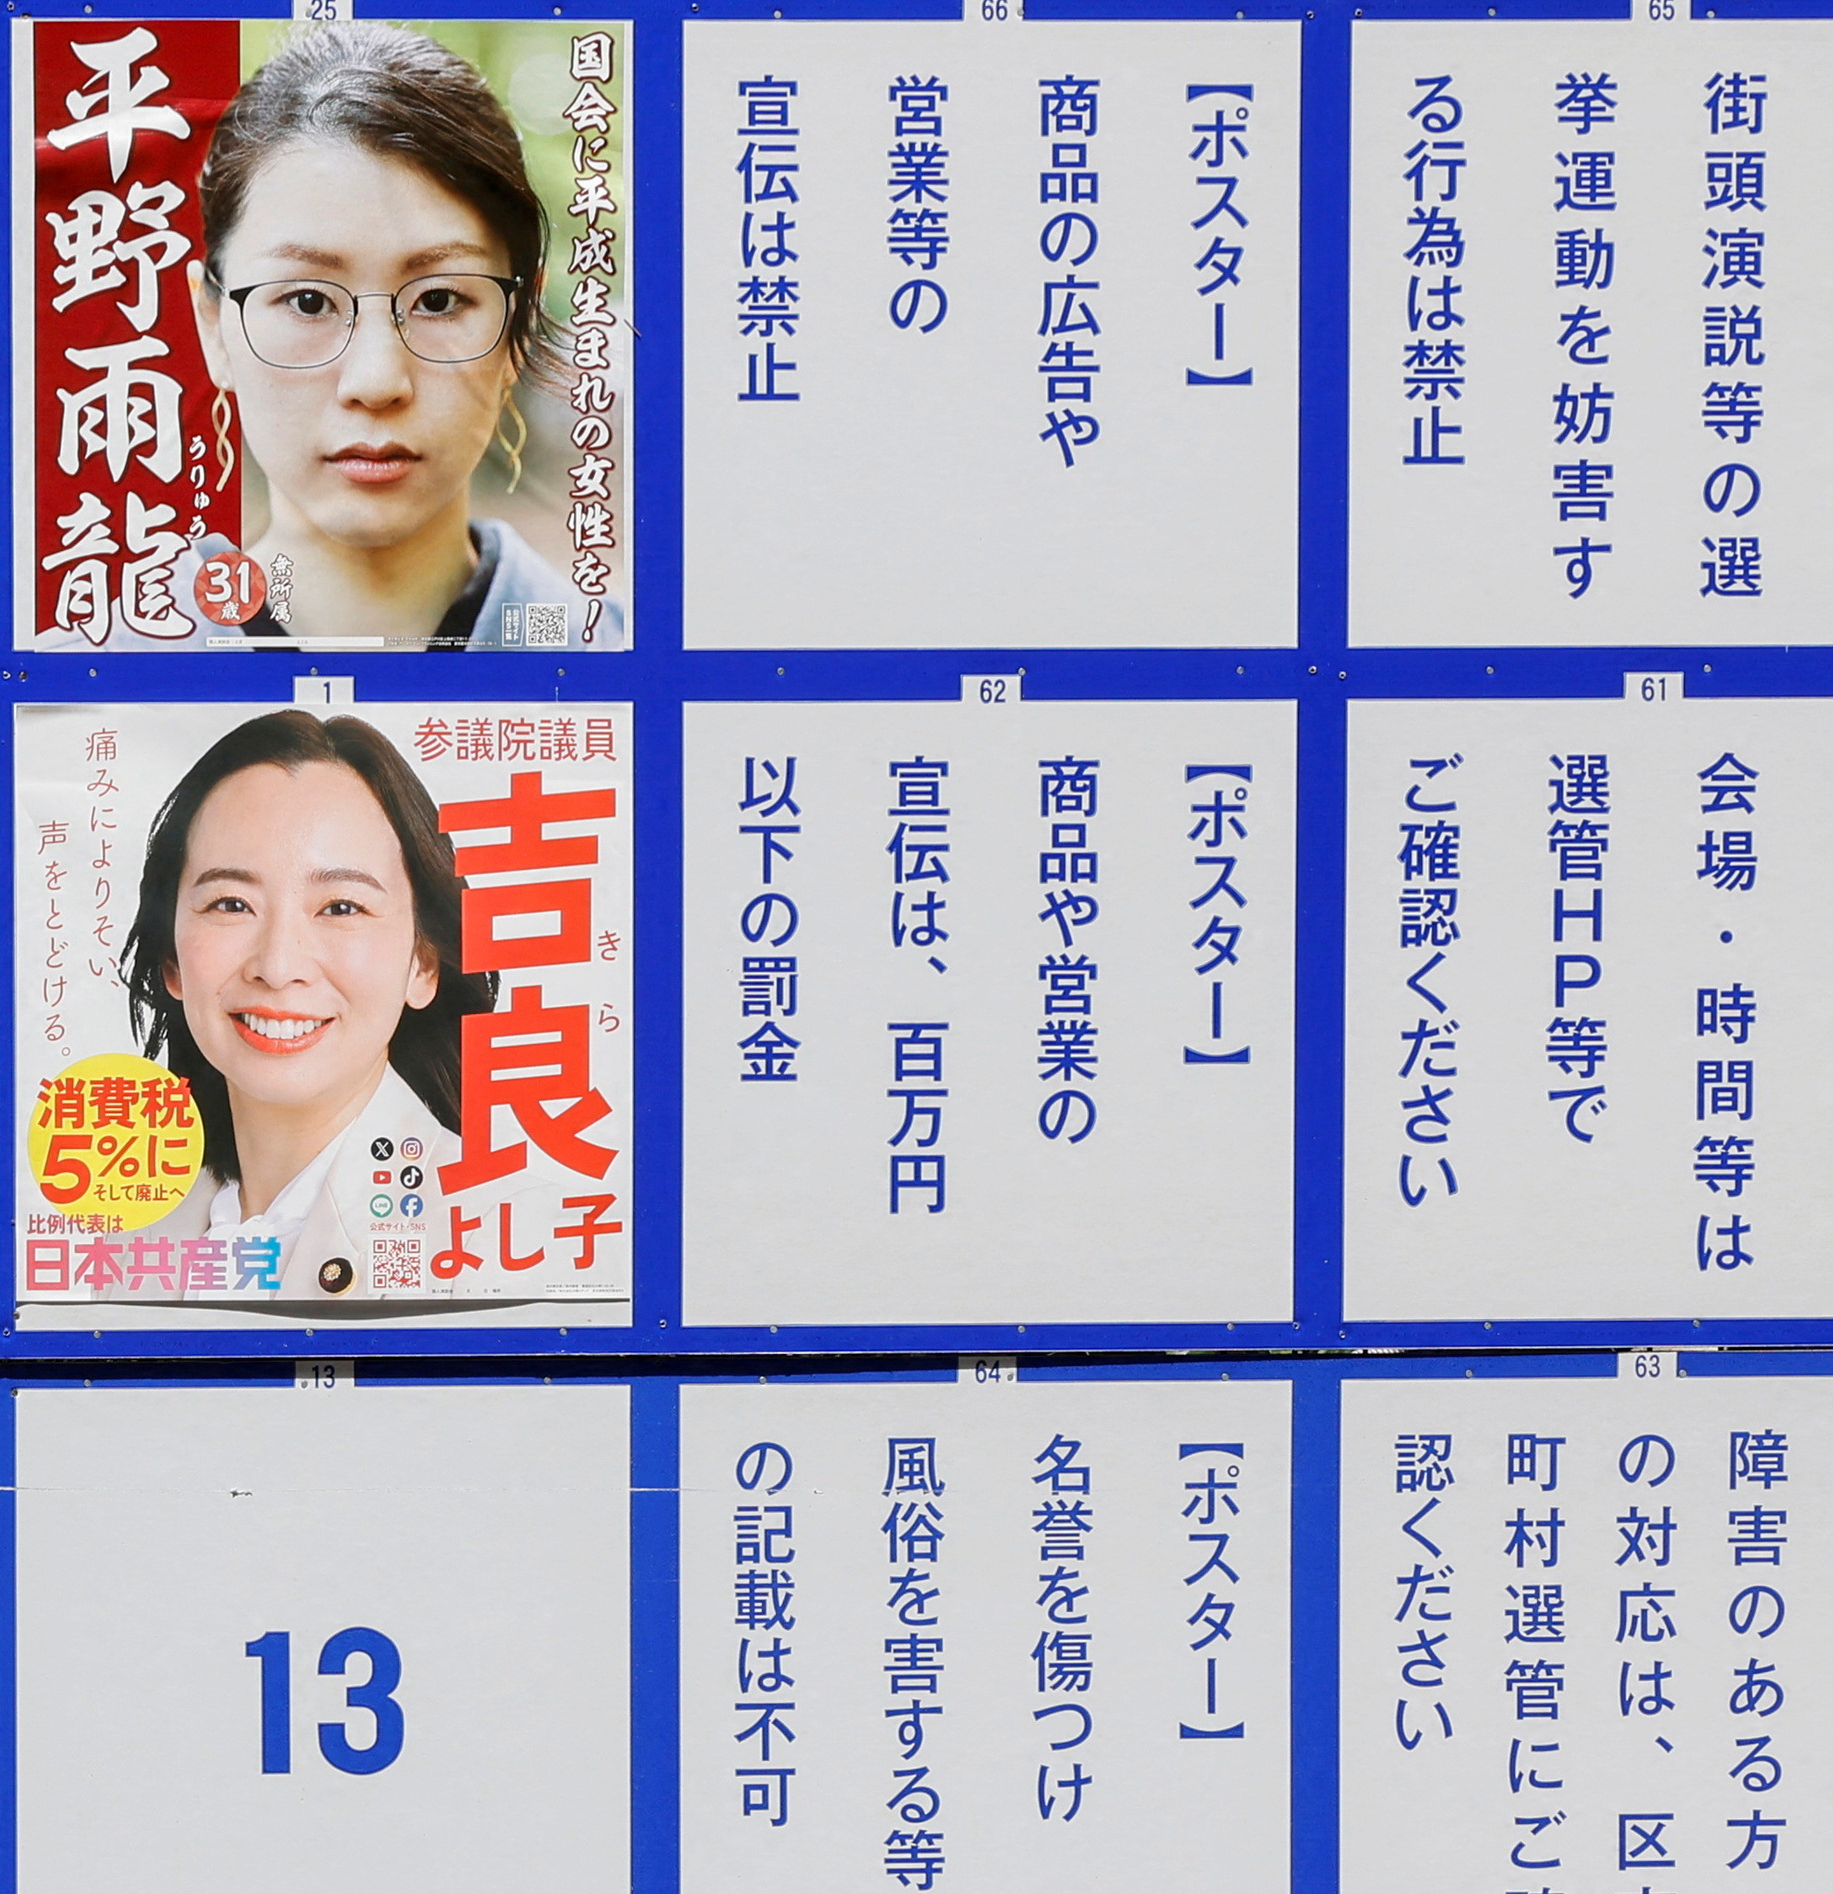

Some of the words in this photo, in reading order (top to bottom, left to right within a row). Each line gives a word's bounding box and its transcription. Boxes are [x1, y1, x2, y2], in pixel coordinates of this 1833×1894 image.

[311, 0, 336, 20] 25
[982, 0, 1008, 21] 66
[1649, 0, 1675, 20] 65
[735, 74, 801, 401] 宣伝は禁止
[887, 74, 949, 334] 営業等の
[1038, 74, 1101, 469] 商品の広告や
[1186, 83, 1253, 385] 【ポスター】
[1402, 74, 1467, 466] る行為は禁止
[41, 27, 197, 644] 平野雨龍
[564, 30, 616, 643] 国会に平成生まれの女性を！
[1551, 72, 1618, 599] 挙運動を妨害す
[1699, 72, 1768, 598] 街頭演説等の選
[189, 435, 210, 540] うりゅう
[205, 561, 250, 604] 31
[221, 602, 240, 620] 歳
[270, 553, 294, 624] 無所属
[323, 681, 331, 704] 1
[413, 717, 618, 763] 参議院議員
[979, 680, 1006, 704] 62
[1641, 677, 1668, 702] 61
[37, 818, 73, 1058] 声をとどける。
[85, 727, 120, 988] 痛みによりそい、
[737, 756, 802, 1083] 以下の罰金
[1037, 755, 1100, 1144] 商品や営業の
[1183, 764, 1252, 1065] 【ポスター】
[1398, 752, 1464, 1208] ご確認ください
[1545, 753, 1611, 1144] 選管HP等で
[37, 1078, 194, 1130] 消費税
[437, 771, 619, 1197] 吉良
[885, 755, 951, 1215] 宣伝は、百万円
[1693, 752, 1760, 1271] 会場・時間等は
[26, 1235, 282, 1292] 日本共産党
[27, 1213, 123, 1234] 比例代表は
[39, 1134, 191, 1204] 5%に
[94, 1184, 185, 1203] そして廃止へ
[369, 1222, 426, 1232] 公式サイト・SNS
[430, 1193, 623, 1280] よし子
[311, 1366, 335, 1388] 13
[974, 1360, 1001, 1384] 64
[1634, 1355, 1661, 1379] 63
[244, 1626, 405, 1775] 13
[733, 1440, 797, 1827] の記載は不可
[881, 1436, 946, 1892] 風俗を害する等
[1030, 1434, 1094, 1823] 名誉を傷つけ
[1178, 1441, 1245, 1739] 【ポスター】
[1394, 1433, 1456, 1752] 認ください
